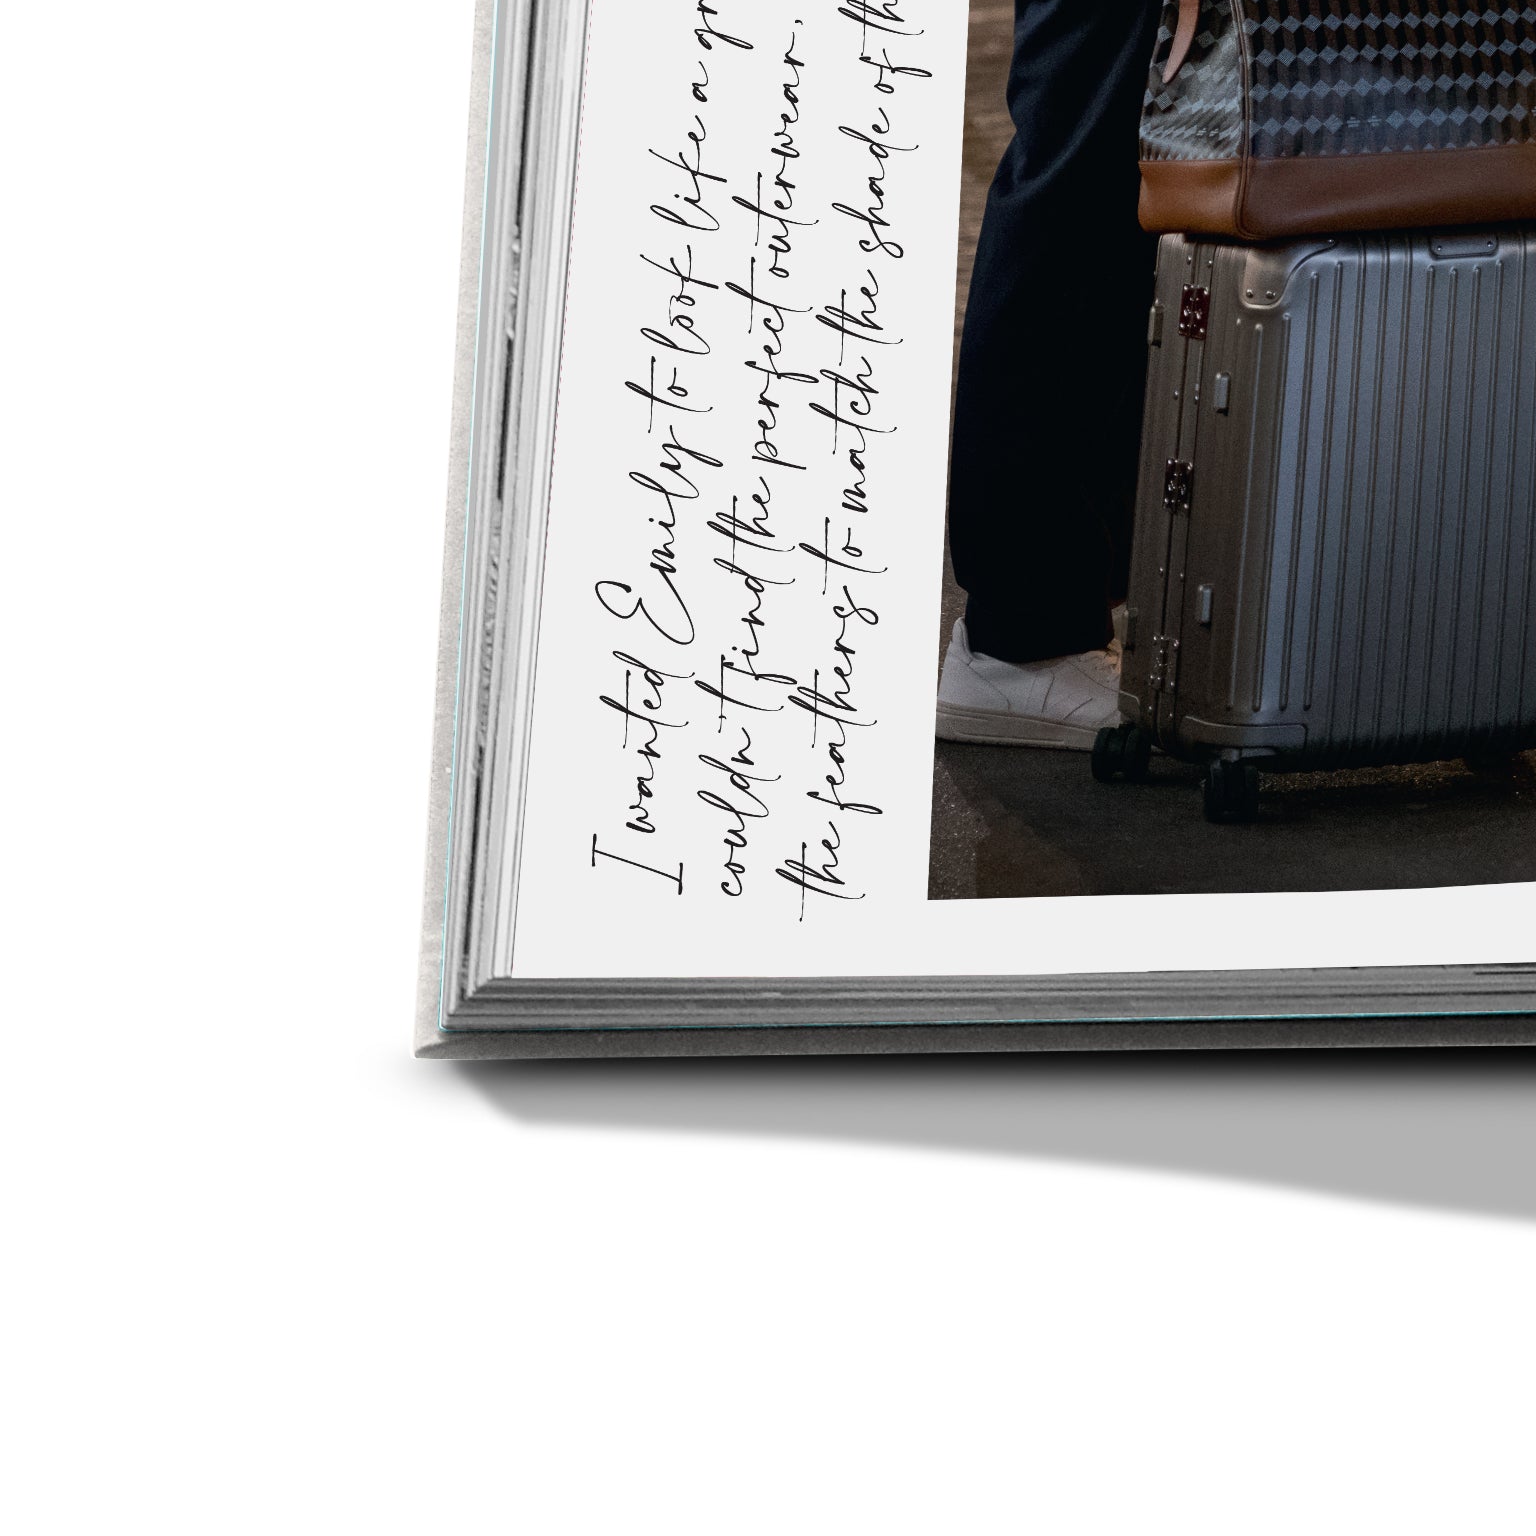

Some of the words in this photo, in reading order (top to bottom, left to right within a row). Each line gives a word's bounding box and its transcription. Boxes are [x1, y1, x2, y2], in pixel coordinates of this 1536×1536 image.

[692, 61, 708, 102] a
[860, 49, 932, 94] of
[648, 115, 727, 231] like
[831, 107, 919, 258] shade
[640, 245, 719, 355] look
[815, 269, 903, 366] the
[625, 356, 713, 433] to
[725, 258, 812, 469] perfect
[809, 356, 897, 513] match
[595, 425, 722, 645] Emily
[707, 477, 795, 572] the
[799, 517, 888, 595] to
[713, 559, 796, 685] find
[599, 651, 695, 833] wanted
[788, 586, 882, 814] feathers
[592, 833, 683, 895] I
[775, 821, 866, 922] the
